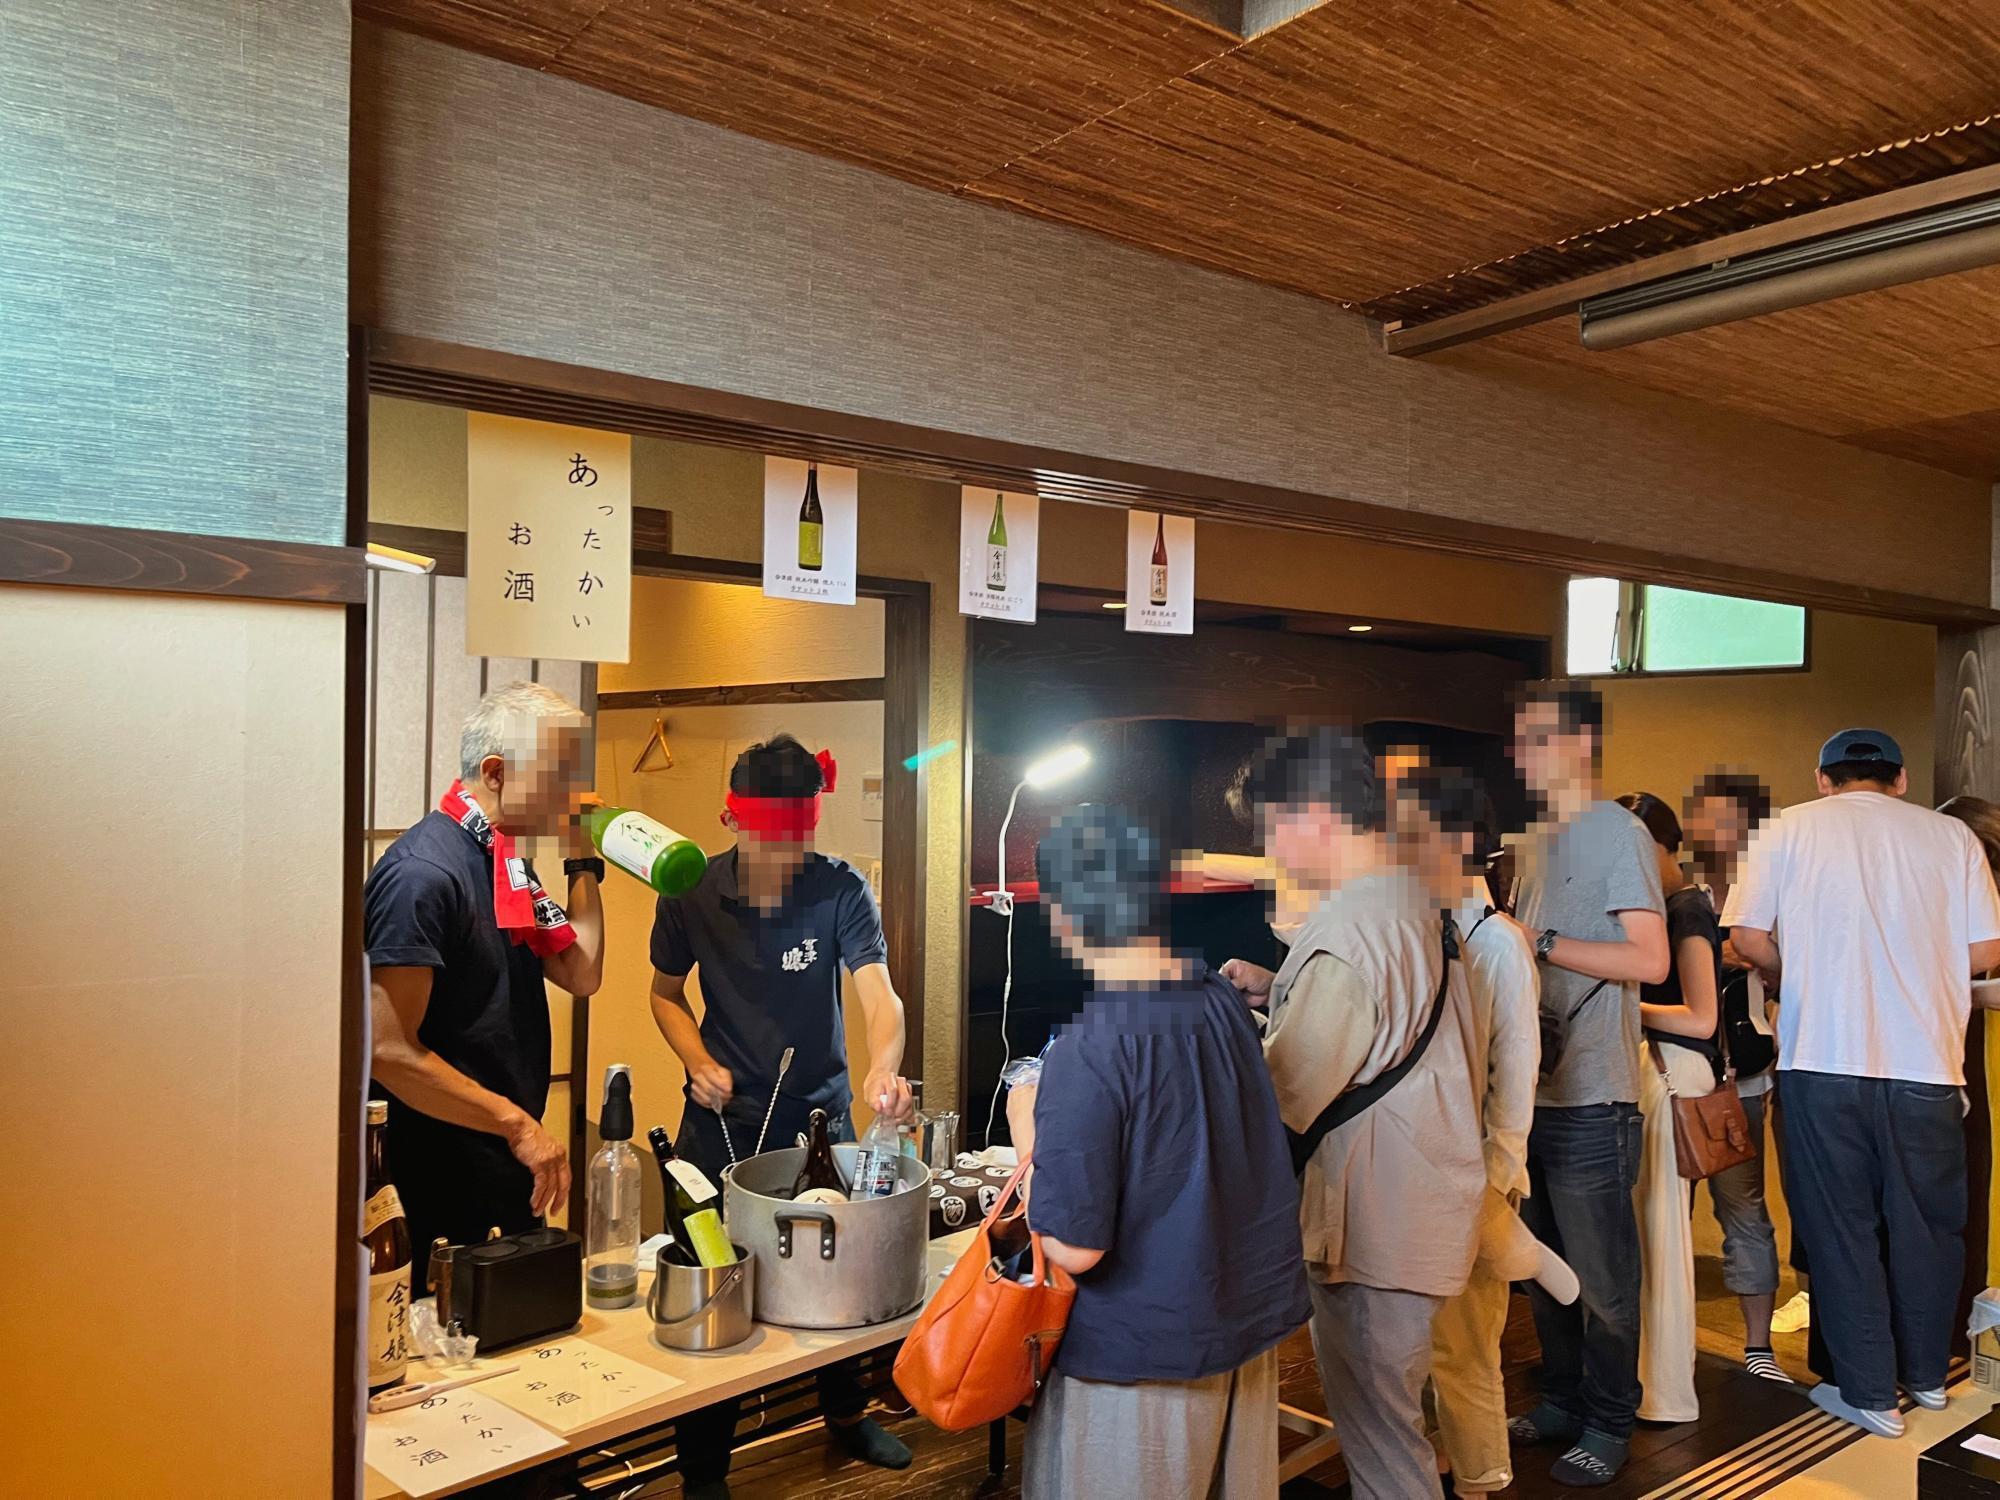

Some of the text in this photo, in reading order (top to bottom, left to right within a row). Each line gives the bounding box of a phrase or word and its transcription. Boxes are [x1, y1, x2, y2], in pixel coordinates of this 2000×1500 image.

[504, 522, 535, 603] お酒
[568, 452, 614, 629] あったかい
[525, 1380, 582, 1407] お酒
[393, 1435, 449, 1467] お酒
